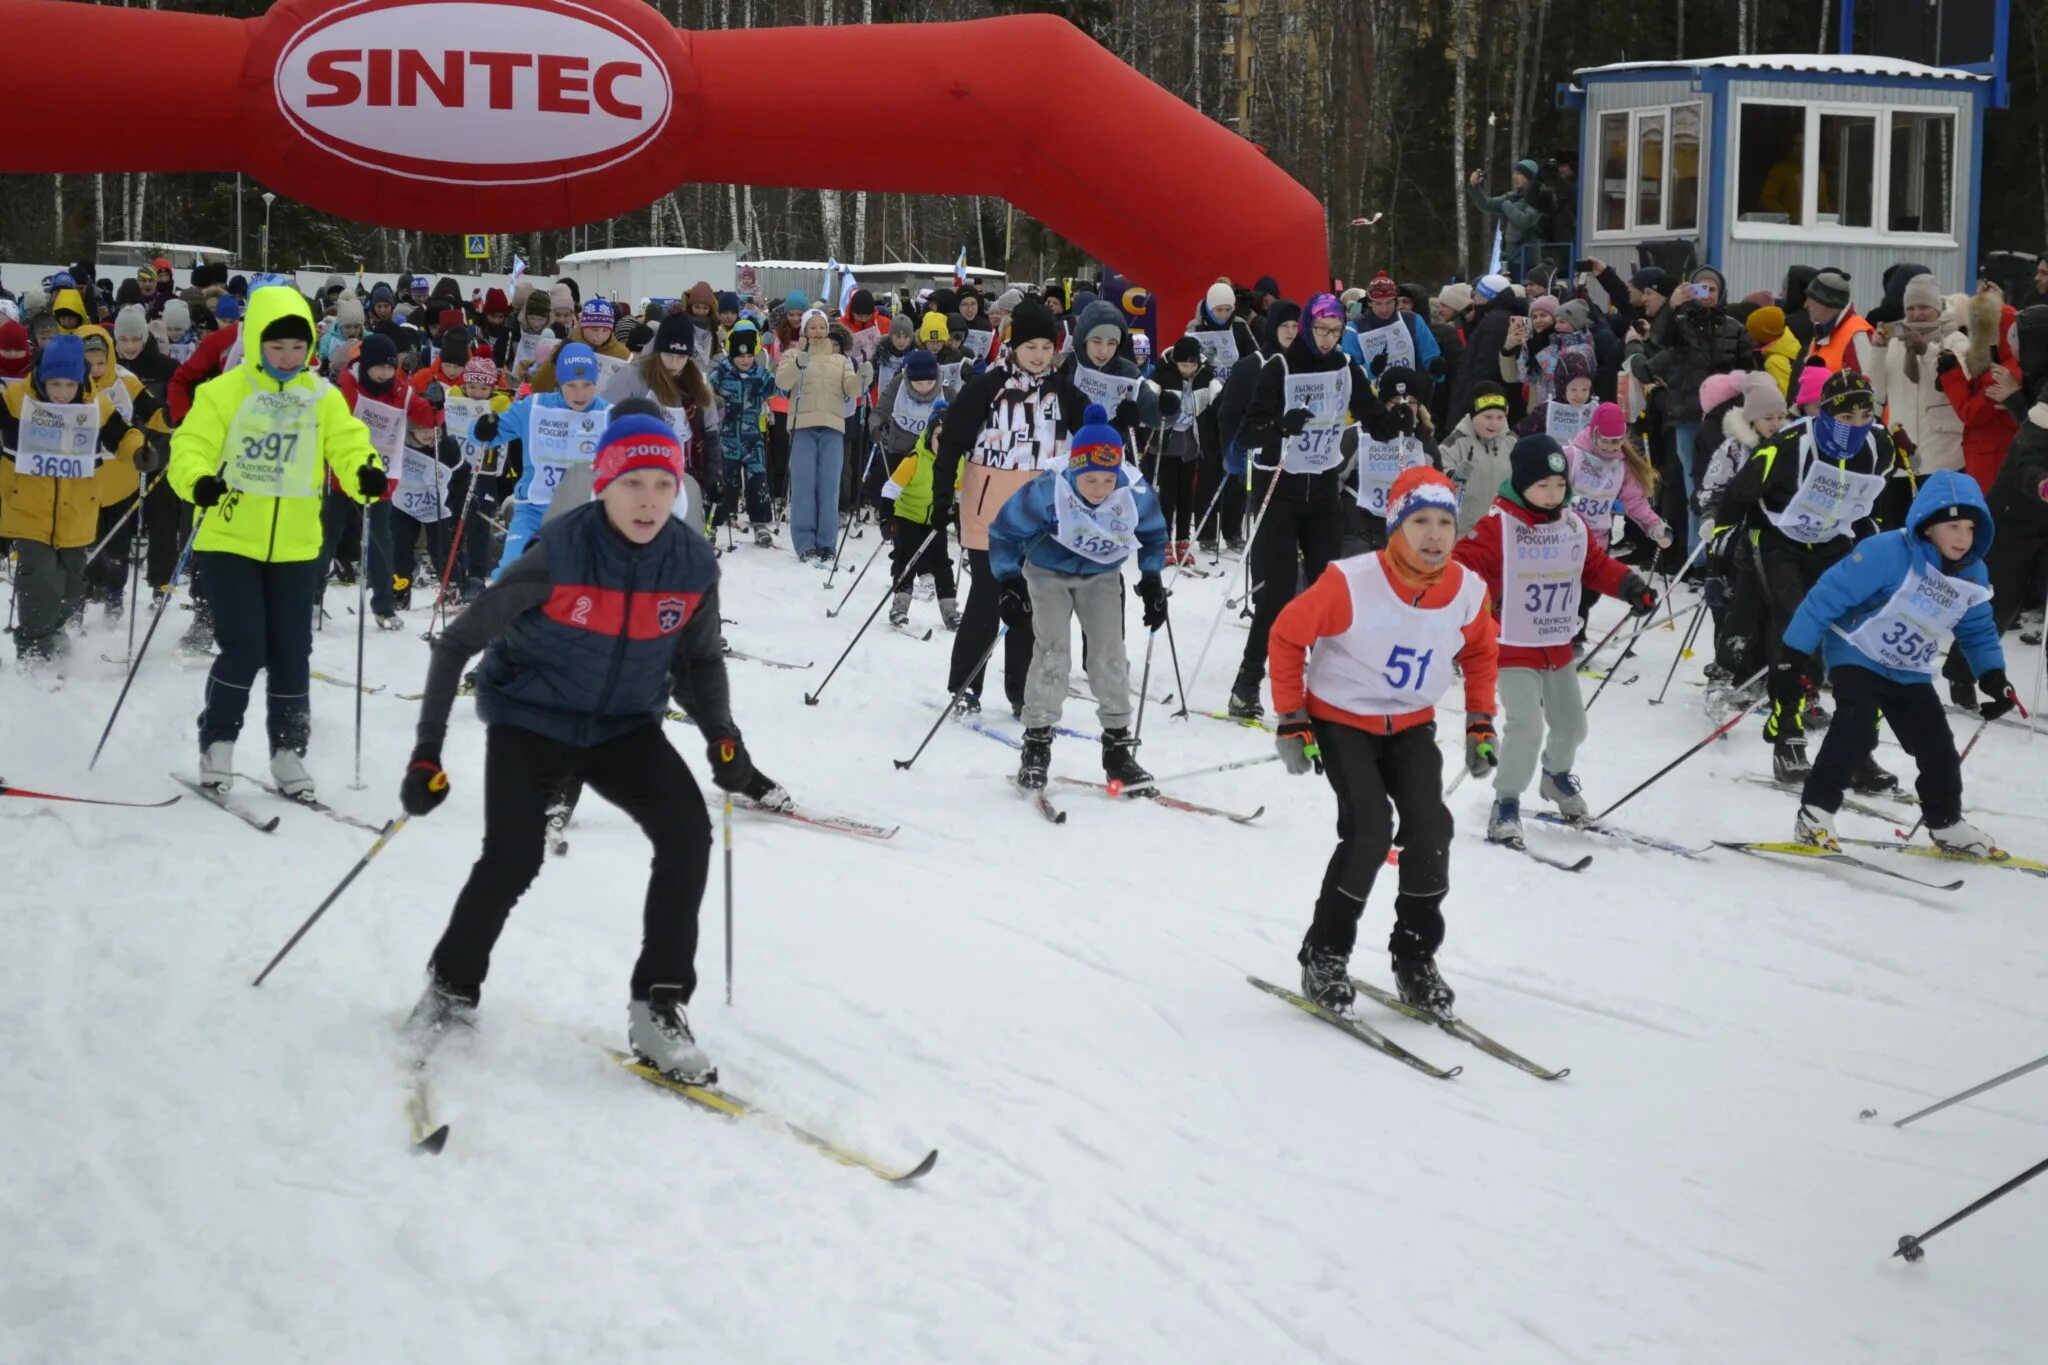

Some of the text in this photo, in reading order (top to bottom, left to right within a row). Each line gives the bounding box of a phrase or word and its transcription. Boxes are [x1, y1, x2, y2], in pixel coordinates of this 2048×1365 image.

[306, 48, 643, 120] SINTEC
[564, 357, 593, 365] LUKOIL
[1294, 383, 1325, 394] ЛЫЖНЯ
[1294, 393, 1325, 402] РОСИИ
[30, 416, 65, 429] РОССИИ
[900, 415, 926, 431] 370
[539, 427, 568, 438] РОССИИ
[1369, 445, 1400, 453] ЛЫЖНЯ
[1369, 453, 1400, 461] РОССИИ
[30, 454, 82, 478] 3690
[543, 465, 567, 487] 37
[1517, 535, 1559, 544] РОССИИ
[1518, 546, 1559, 559] 2023
[1525, 580, 1573, 613] 377
[571, 596, 592, 624] 2
[1533, 615, 1571, 625] КАЛУЖСКА
[1882, 621, 1937, 663] 35
[1382, 644, 1433, 691] 51
